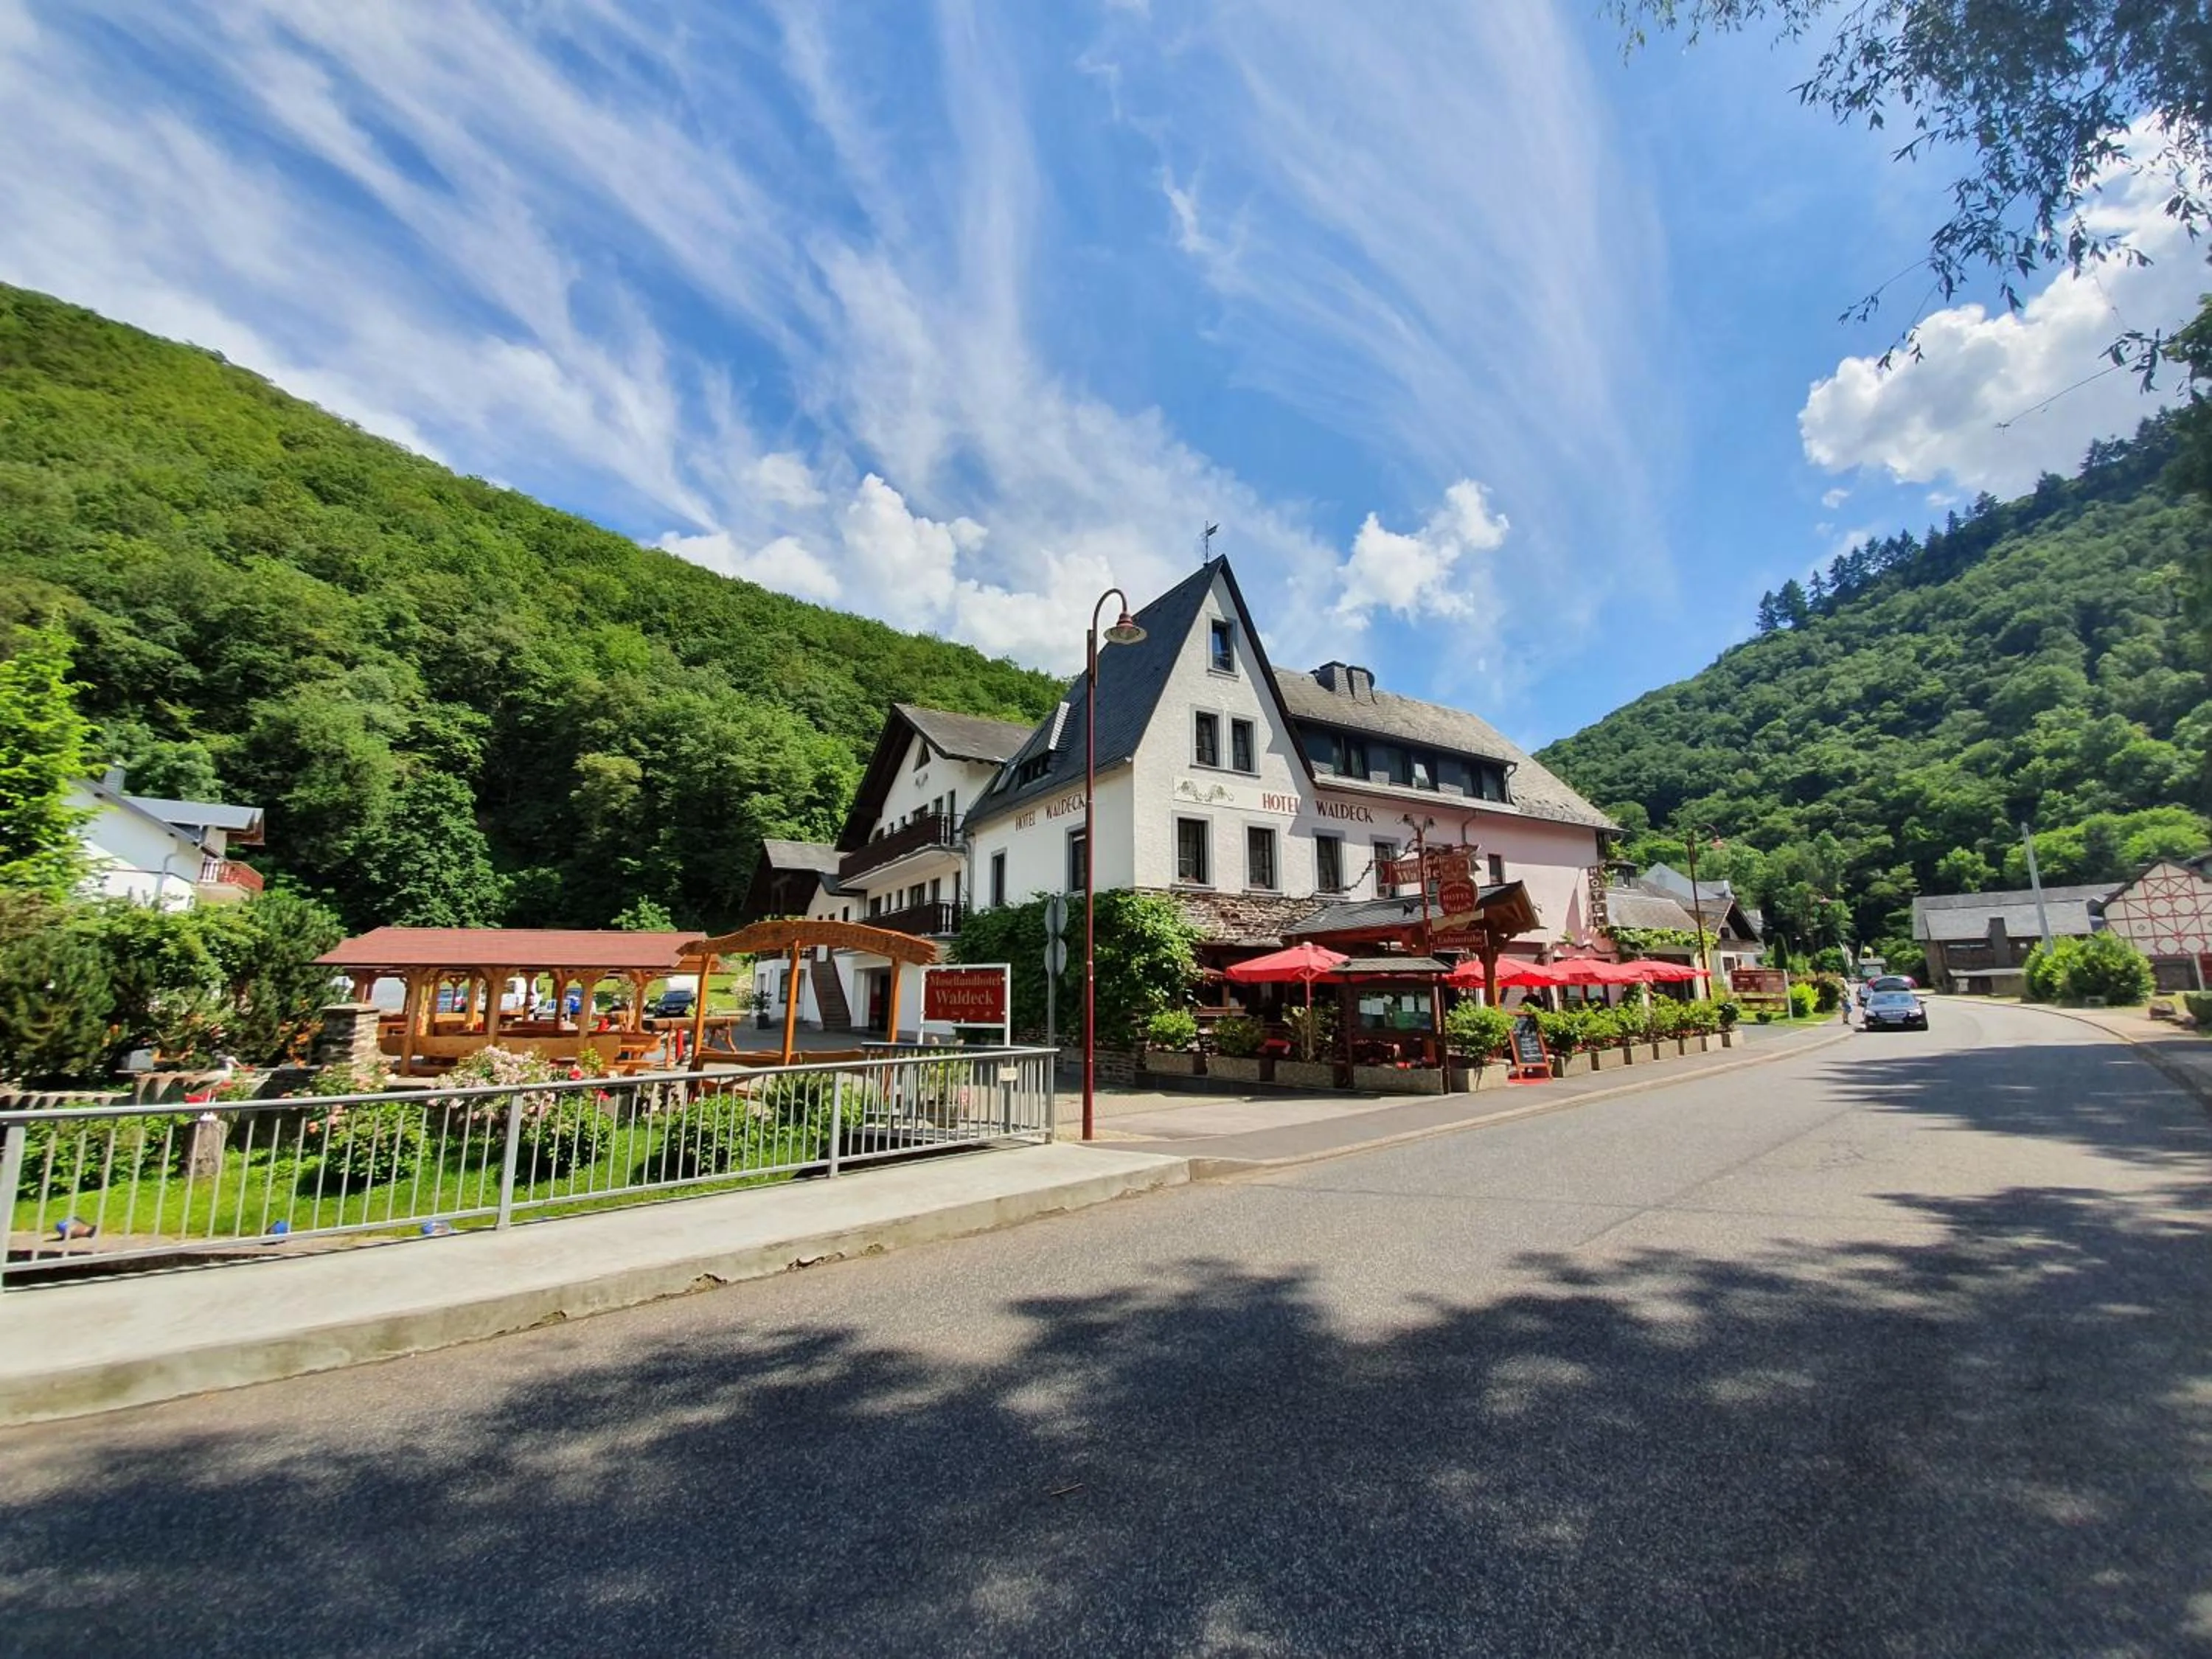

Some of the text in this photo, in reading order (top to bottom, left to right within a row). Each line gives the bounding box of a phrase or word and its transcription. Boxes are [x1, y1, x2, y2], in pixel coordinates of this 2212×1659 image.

[1015, 792, 1087, 832] HOTEL WALDECK
[1262, 793, 1374, 823] HOTEL WALDECK
[1443, 893, 1472, 901] HOTEL
[1590, 867, 1603, 925] HOTEL
[935, 990, 995, 1005] Waldeck
